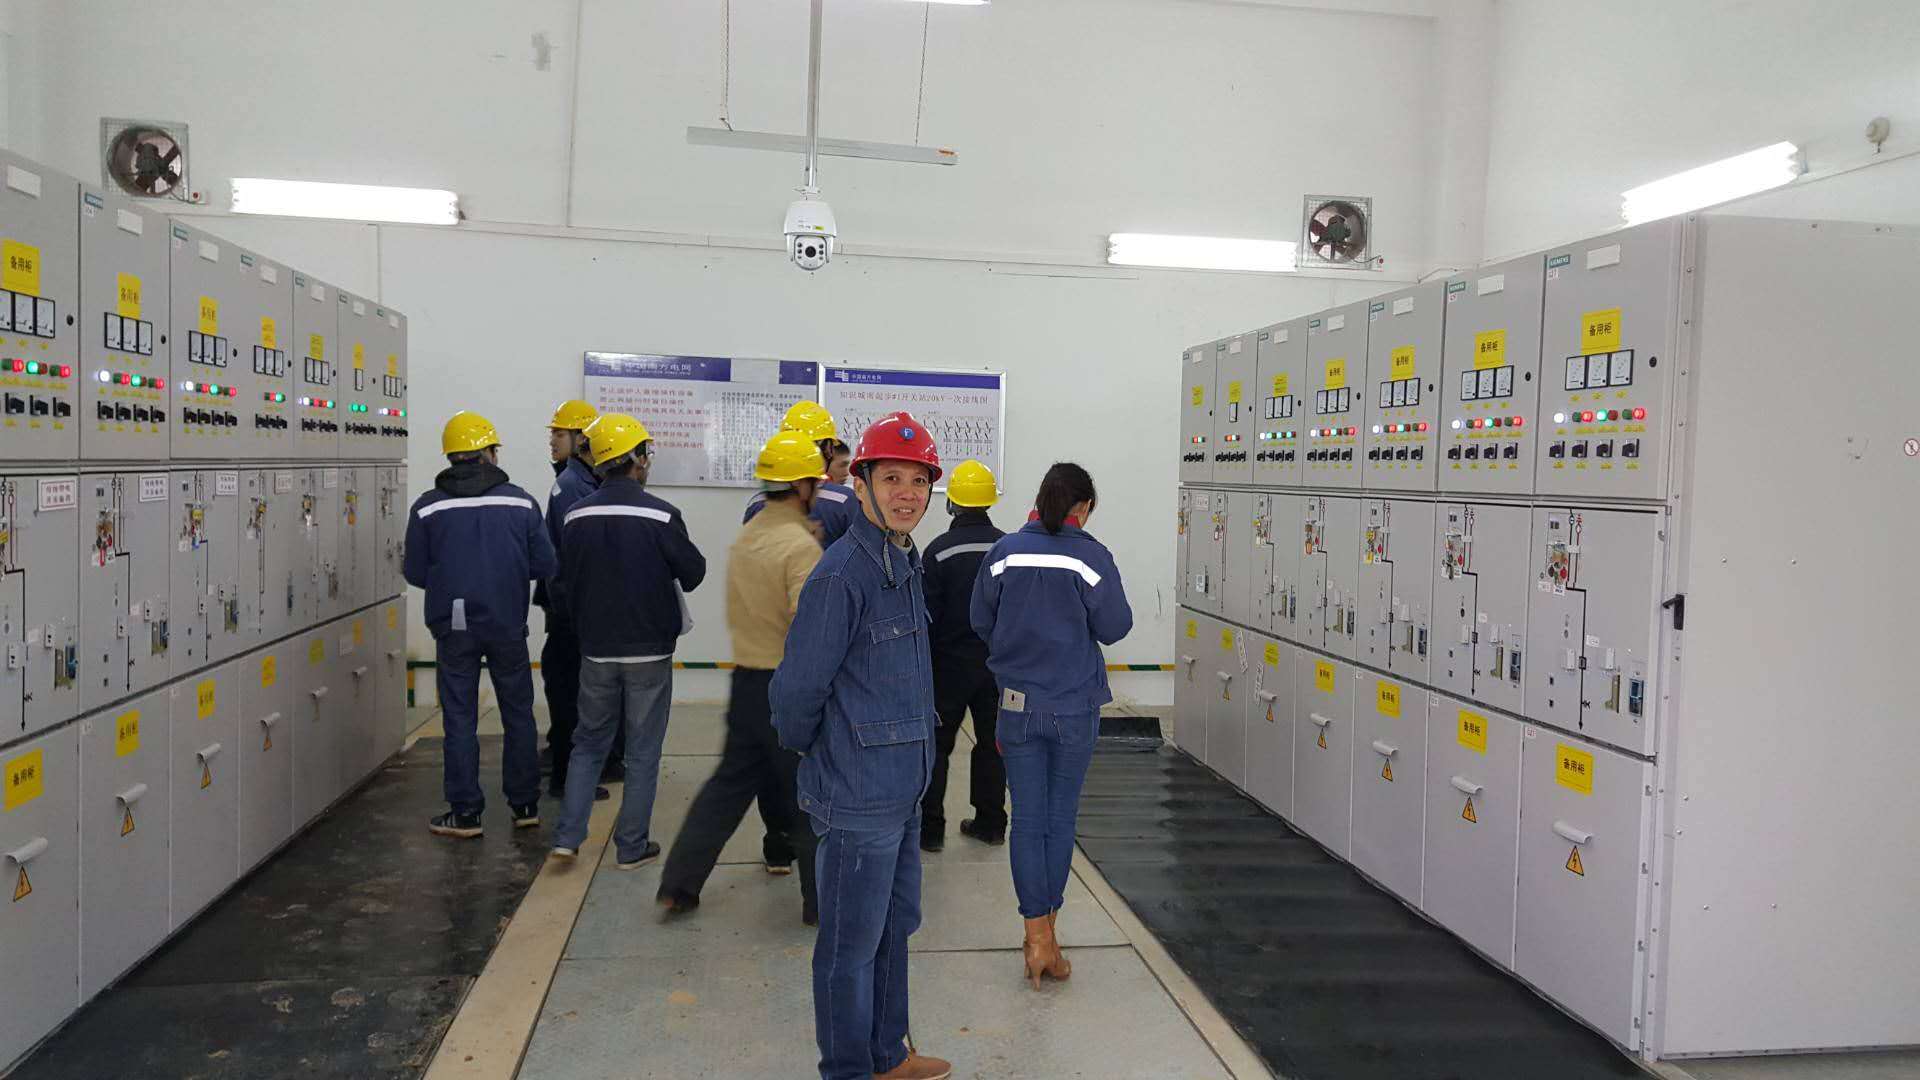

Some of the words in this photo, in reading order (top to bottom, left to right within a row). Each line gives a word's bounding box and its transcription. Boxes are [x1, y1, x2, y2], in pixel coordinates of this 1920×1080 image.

[10, 255, 32, 274] 备用柜
[1589, 321, 1612, 337] 备用柜
[1480, 341, 1498, 353] 备用柜
[1463, 721, 1481, 737] 备用柜
[1563, 758, 1585, 775] 备用柜
[13, 765, 34, 787] 备用柜
